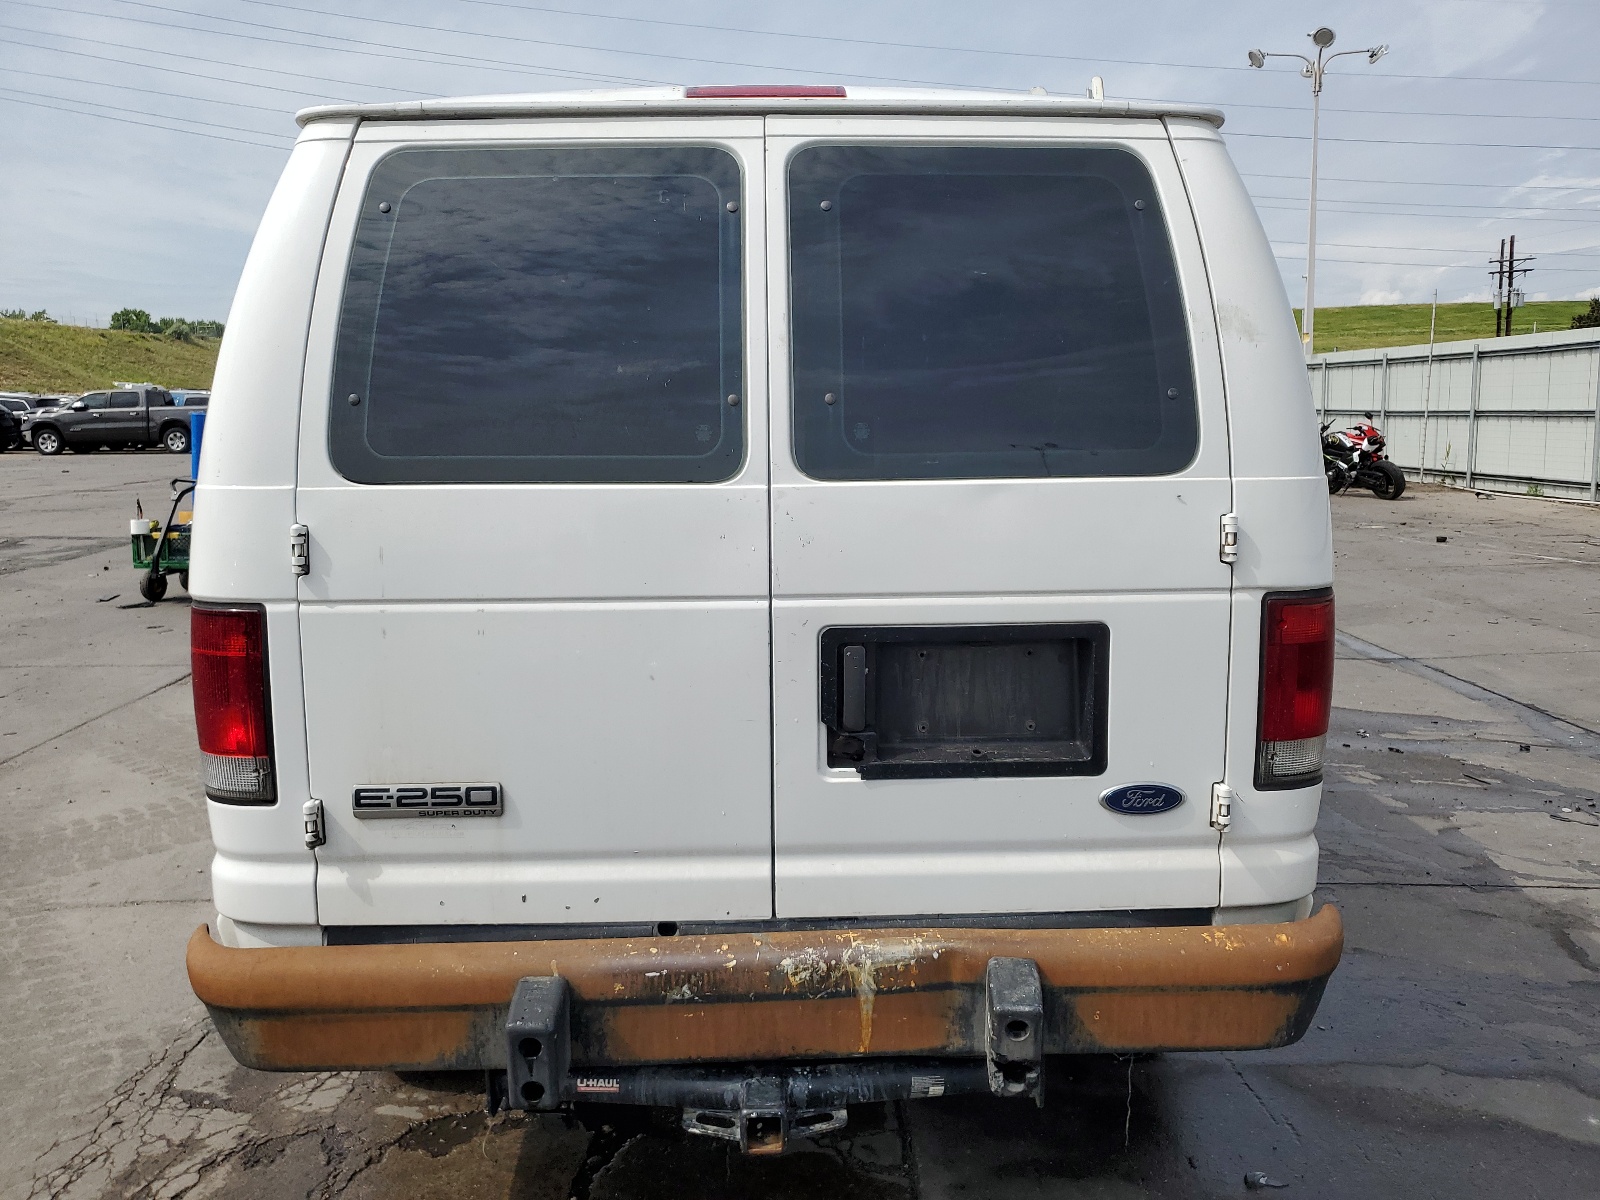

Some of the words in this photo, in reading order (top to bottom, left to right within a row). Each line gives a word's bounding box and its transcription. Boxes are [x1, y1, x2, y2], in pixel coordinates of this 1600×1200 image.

[355, 786, 498, 808] E-250
[1122, 789, 1166, 808] Ford
[576, 1078, 620, 1088] U-HAUL
